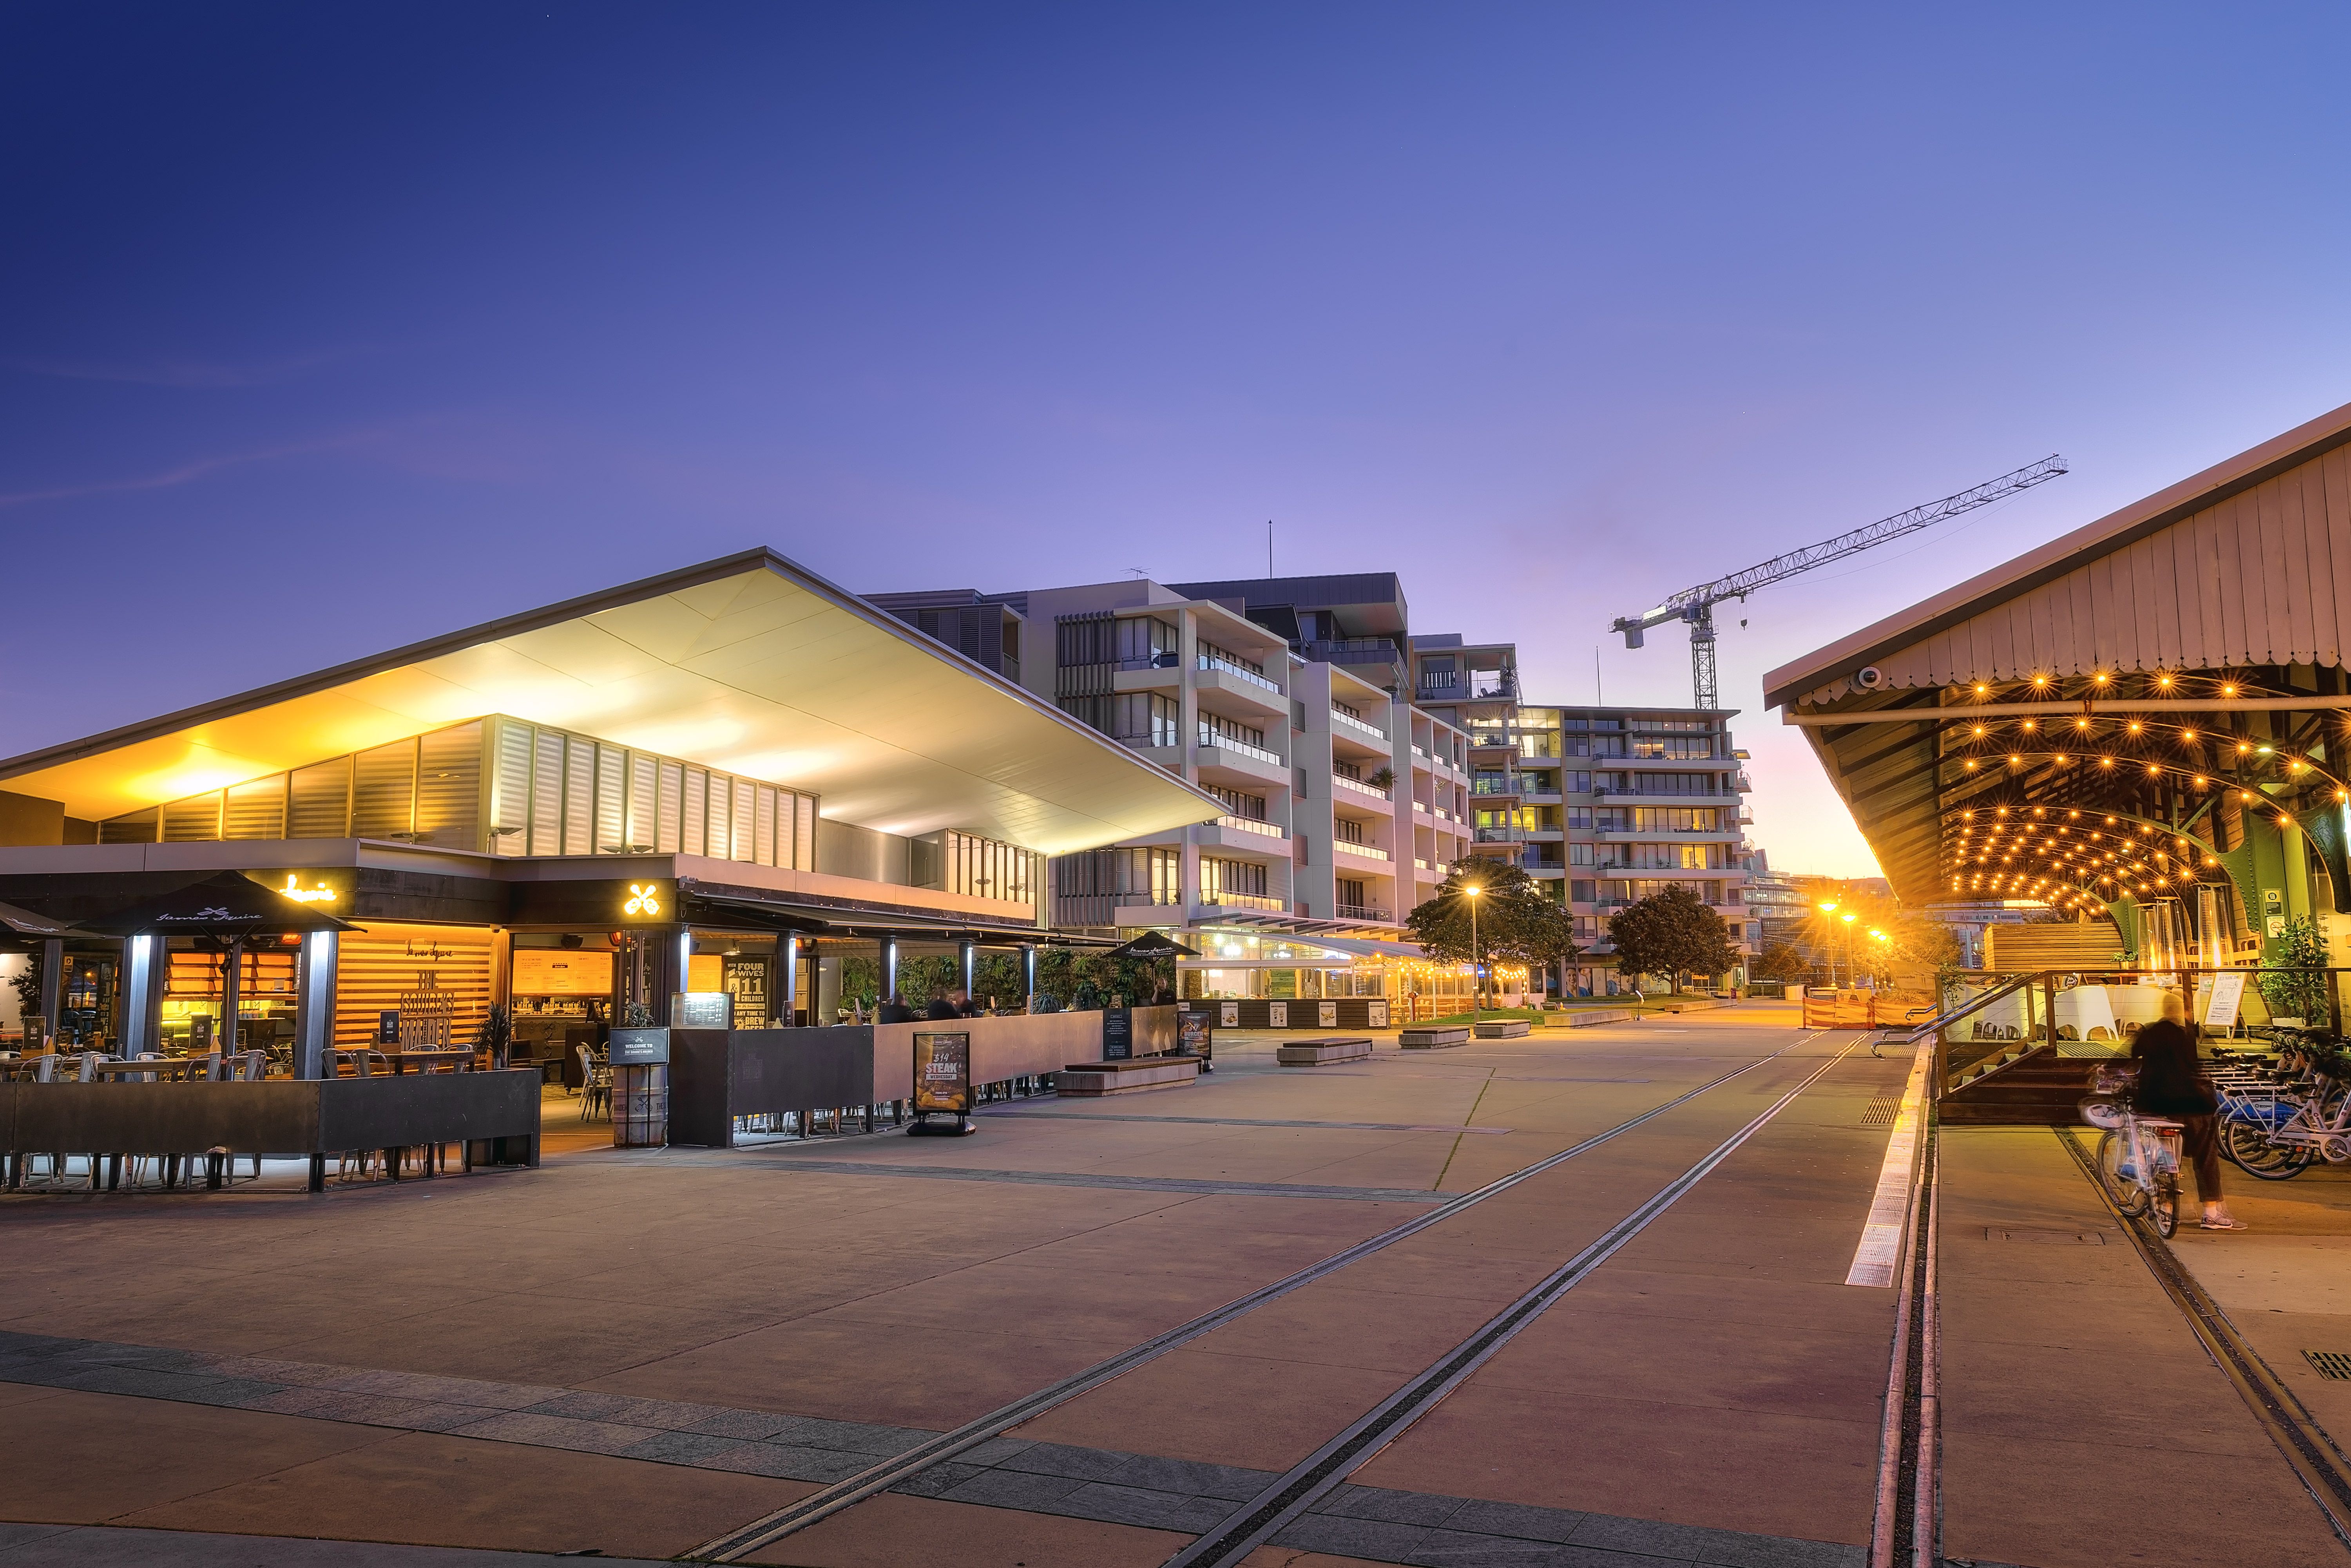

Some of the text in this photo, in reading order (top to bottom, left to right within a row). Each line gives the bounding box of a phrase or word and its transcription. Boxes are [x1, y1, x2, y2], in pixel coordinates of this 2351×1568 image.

[417, 970, 440, 990] THE
[731, 978, 763, 994] & 11
[402, 992, 453, 1015] SQUIRE'S
[745, 1017, 765, 1025] BREW
[401, 1018, 452, 1051] MAIDEN
[933, 1053, 949, 1063] $14
[926, 1063, 957, 1074] STEAK
